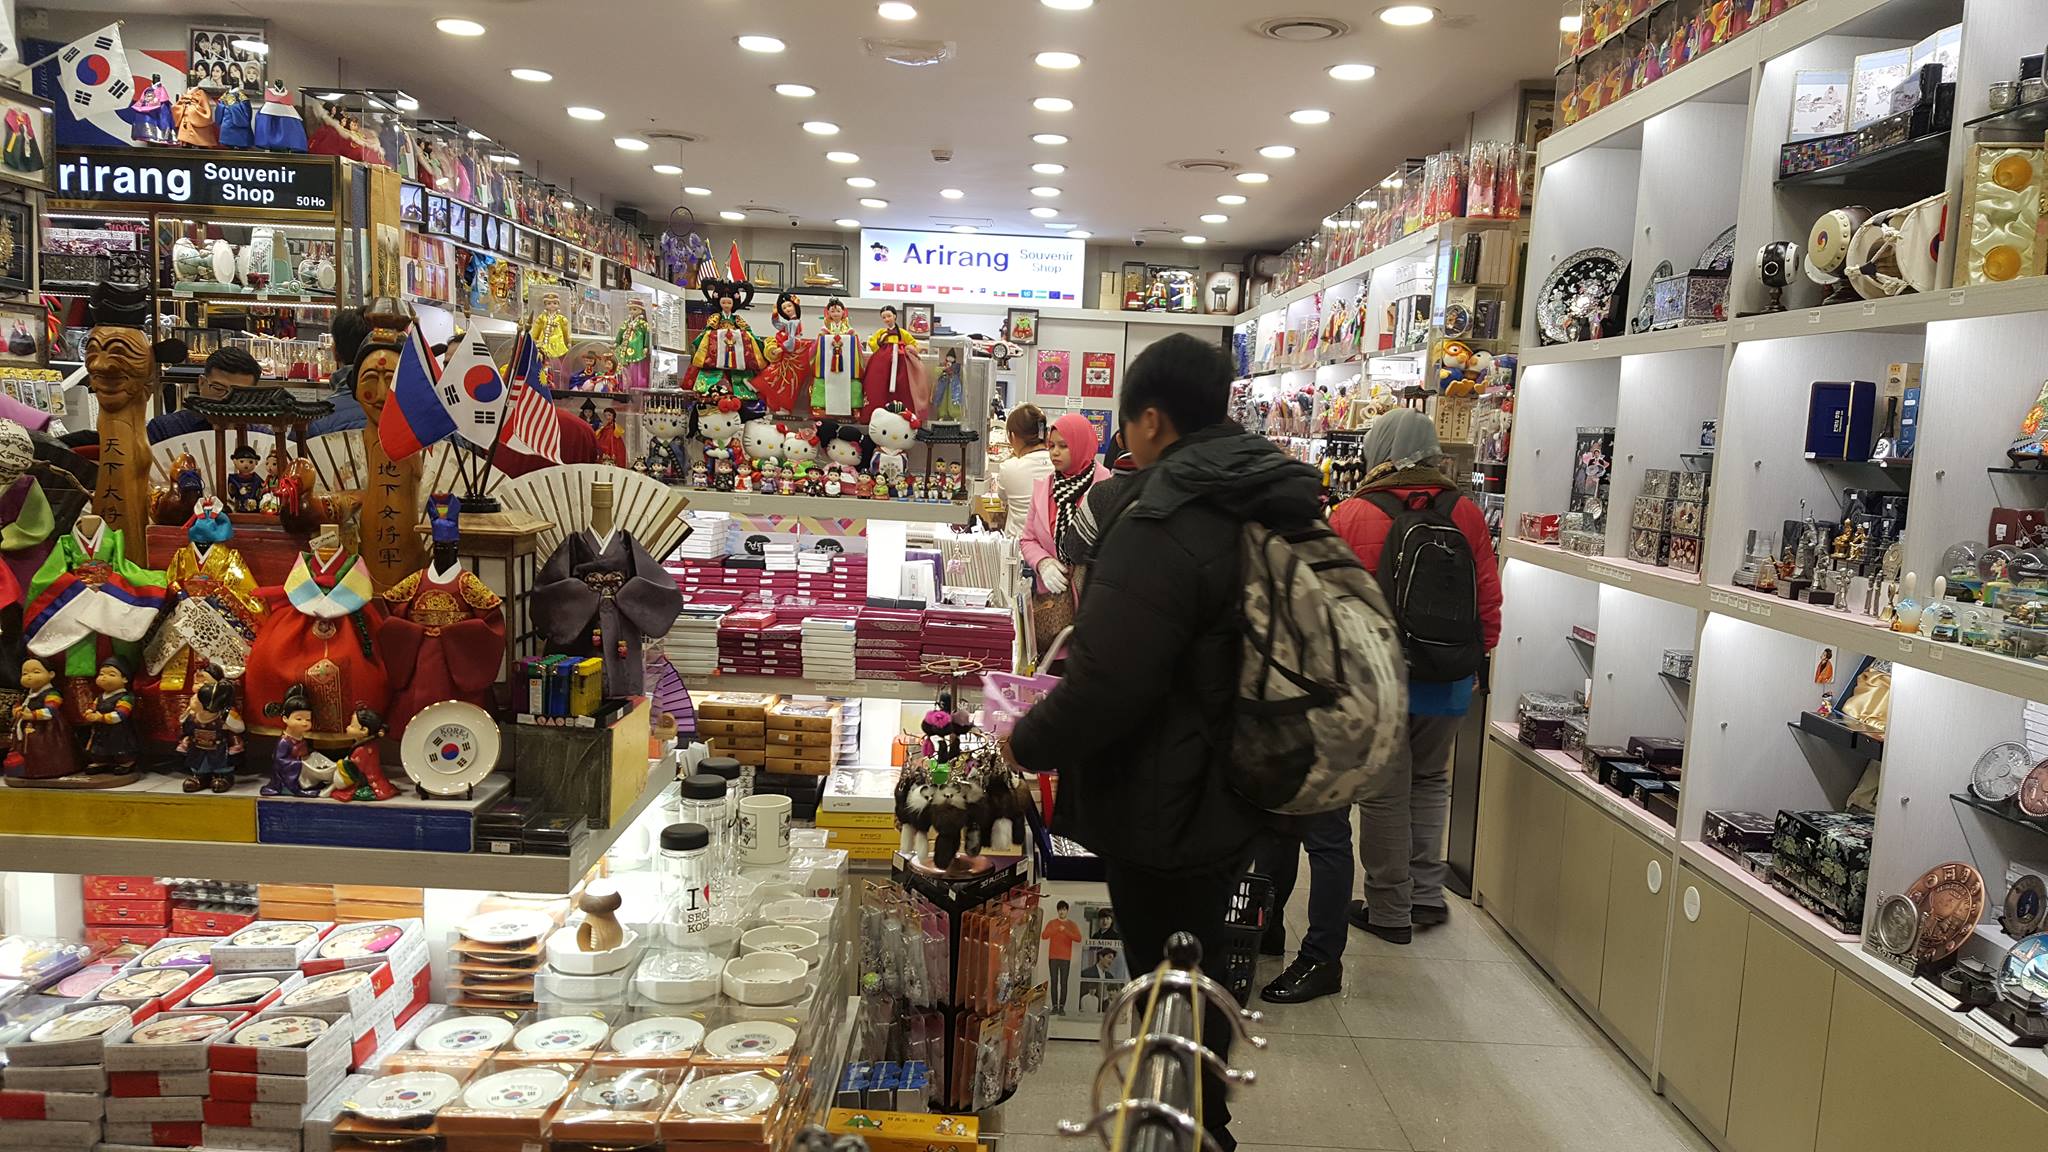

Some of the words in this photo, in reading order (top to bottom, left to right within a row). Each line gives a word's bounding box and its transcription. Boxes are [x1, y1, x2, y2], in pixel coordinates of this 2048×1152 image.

[204, 163, 296, 184] Souvenir
[222, 184, 275, 204] Shop
[903, 242, 1009, 272] Arirang
[1020, 249, 1074, 263] Souvenir
[1032, 262, 1063, 275] Shop
[686, 887, 700, 911] I
